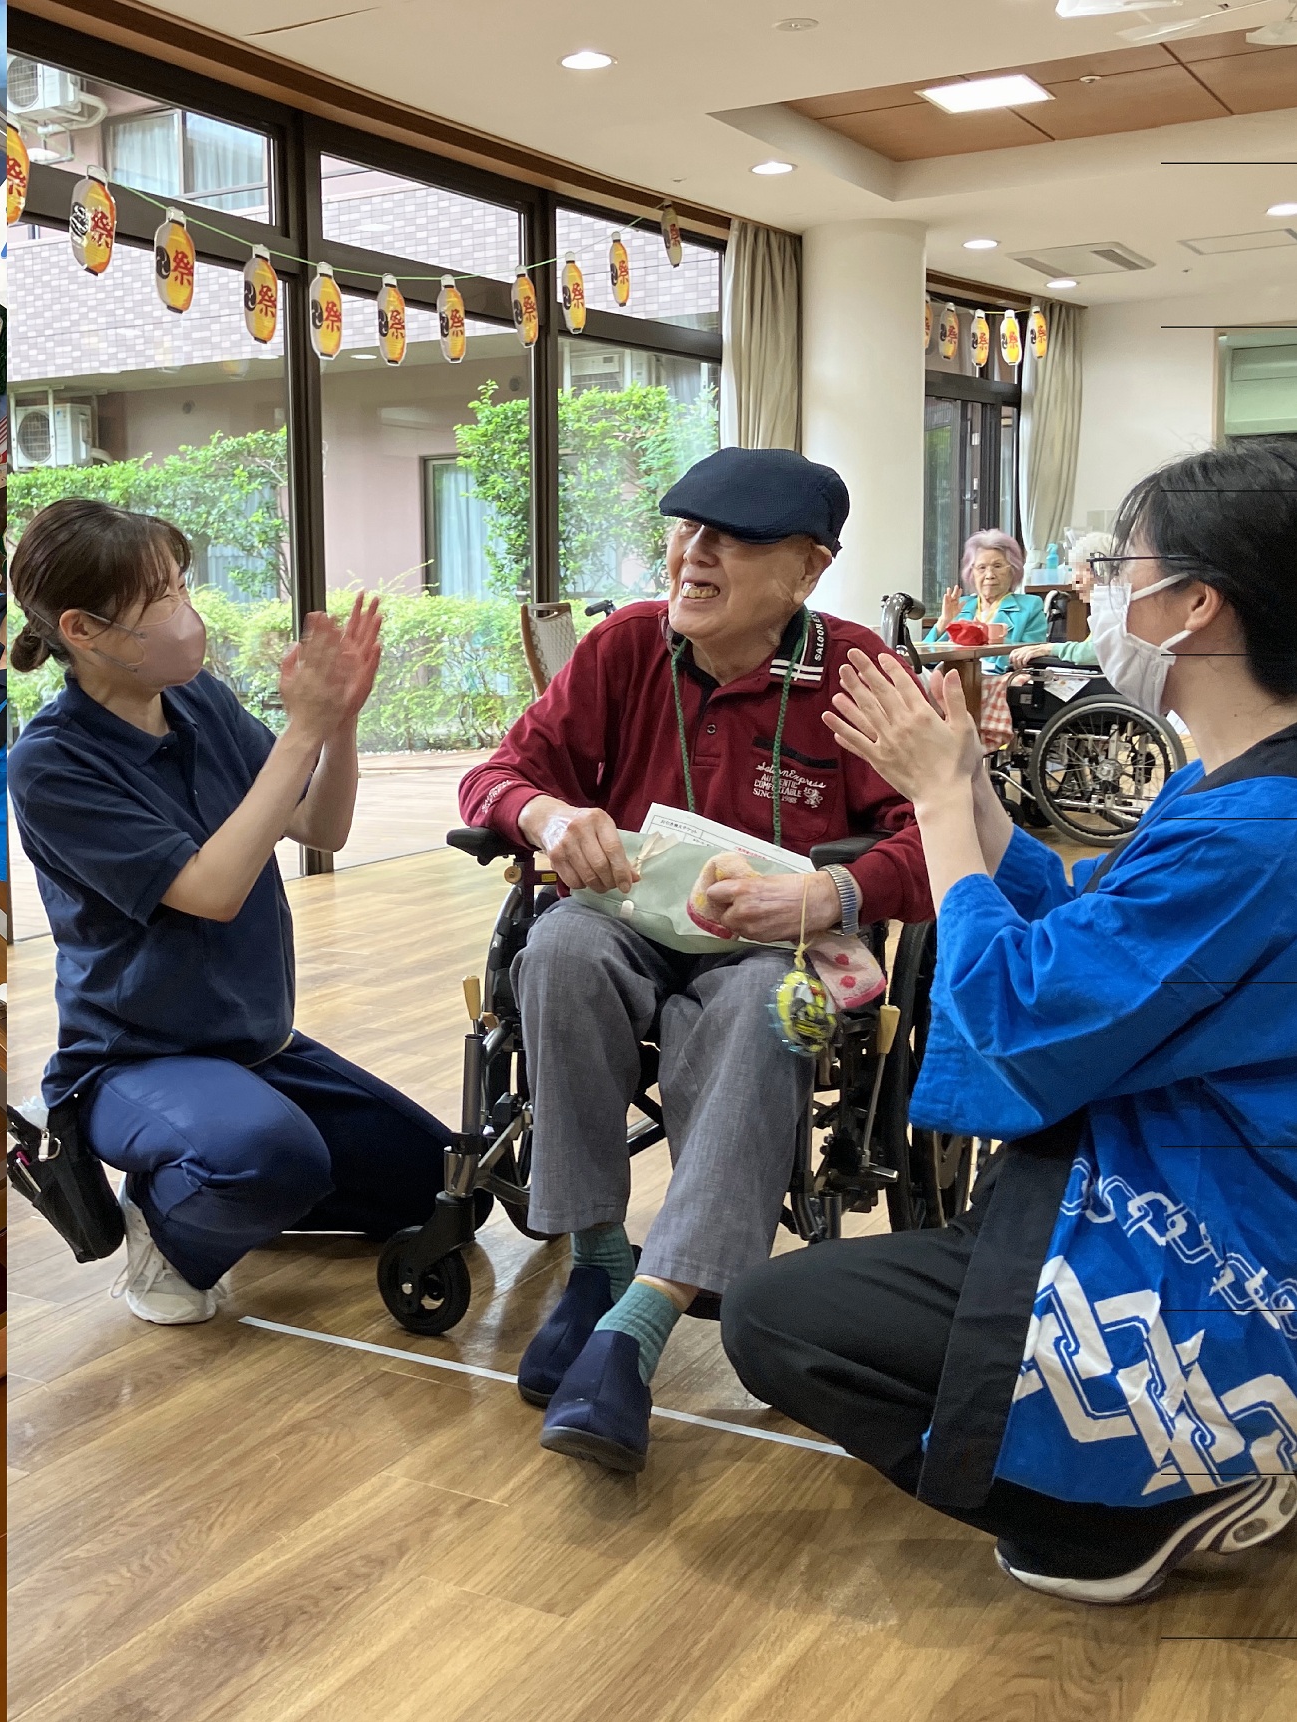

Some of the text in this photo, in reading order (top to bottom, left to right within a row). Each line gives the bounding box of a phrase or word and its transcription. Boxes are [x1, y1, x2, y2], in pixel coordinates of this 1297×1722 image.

[90, 207, 114, 248] 祭
[171, 249, 194, 286] 祭
[618, 260, 629, 285] 祭
[257, 284, 277, 318] 祭
[523, 295, 536, 322] 祭
[571, 282, 584, 309] 祭
[324, 300, 342, 332] 祭
[388, 308, 405, 339] 祭
[449, 308, 464, 337] 祭
[761, 773, 798, 789] AUTENTIC
